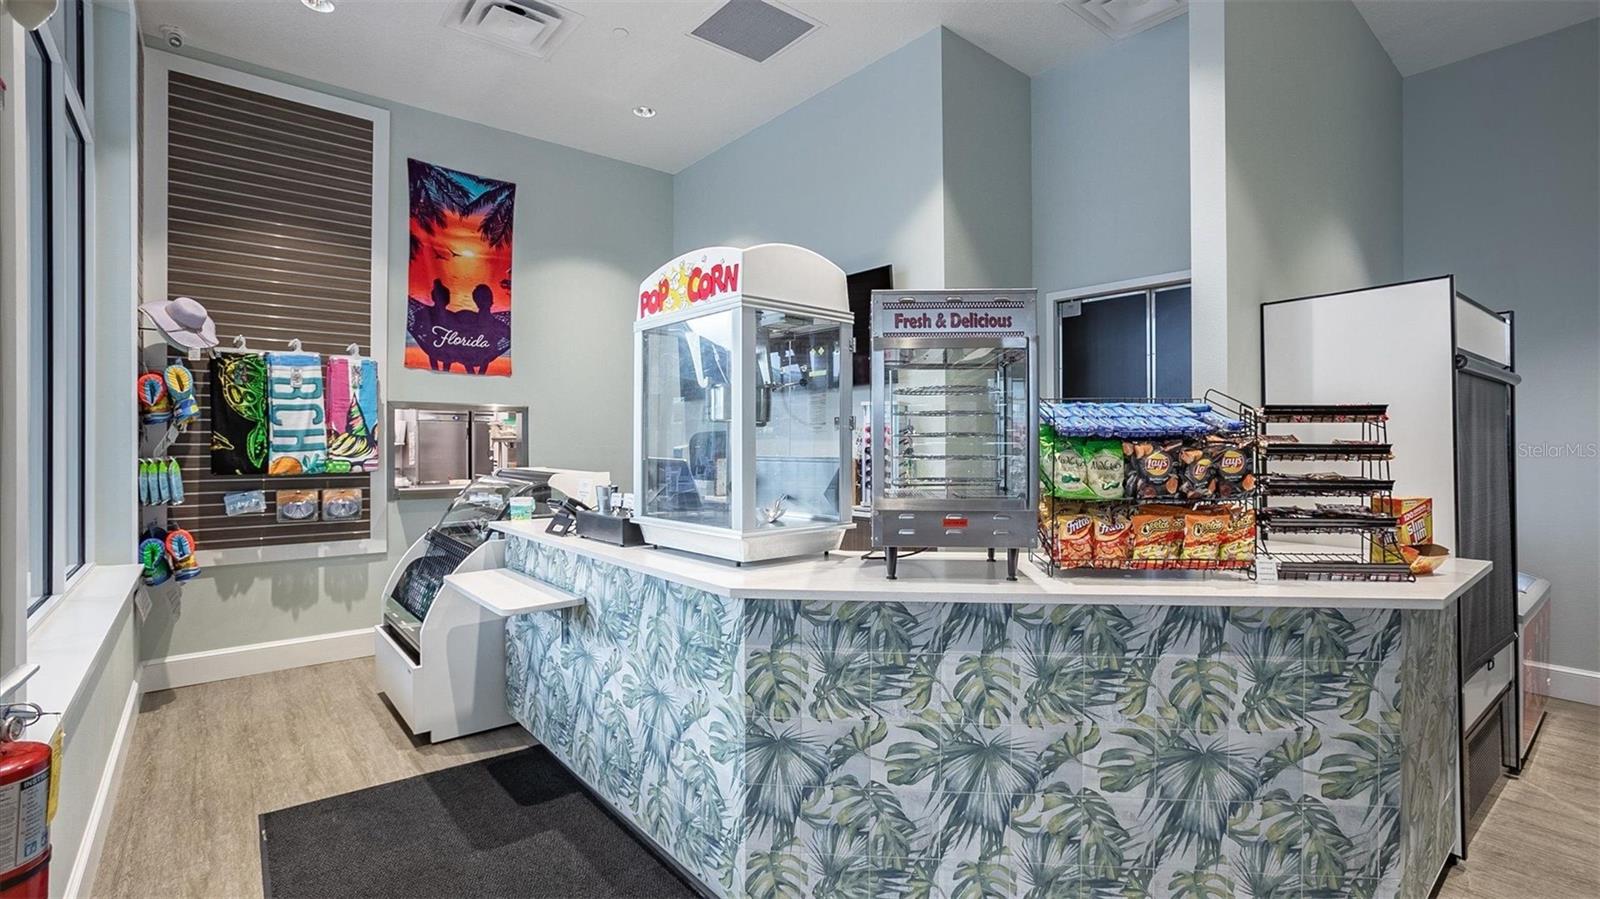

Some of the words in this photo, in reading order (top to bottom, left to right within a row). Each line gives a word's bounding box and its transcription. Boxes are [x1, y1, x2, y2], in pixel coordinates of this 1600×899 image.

[641, 278, 669, 319] POP
[687, 263, 739, 302] CORN
[894, 312, 932, 329] Fresh
[935, 312, 947, 329] &
[950, 312, 1012, 328] Delicious
[432, 325, 490, 348] Florida
[1067, 517, 1091, 534] Fritos
